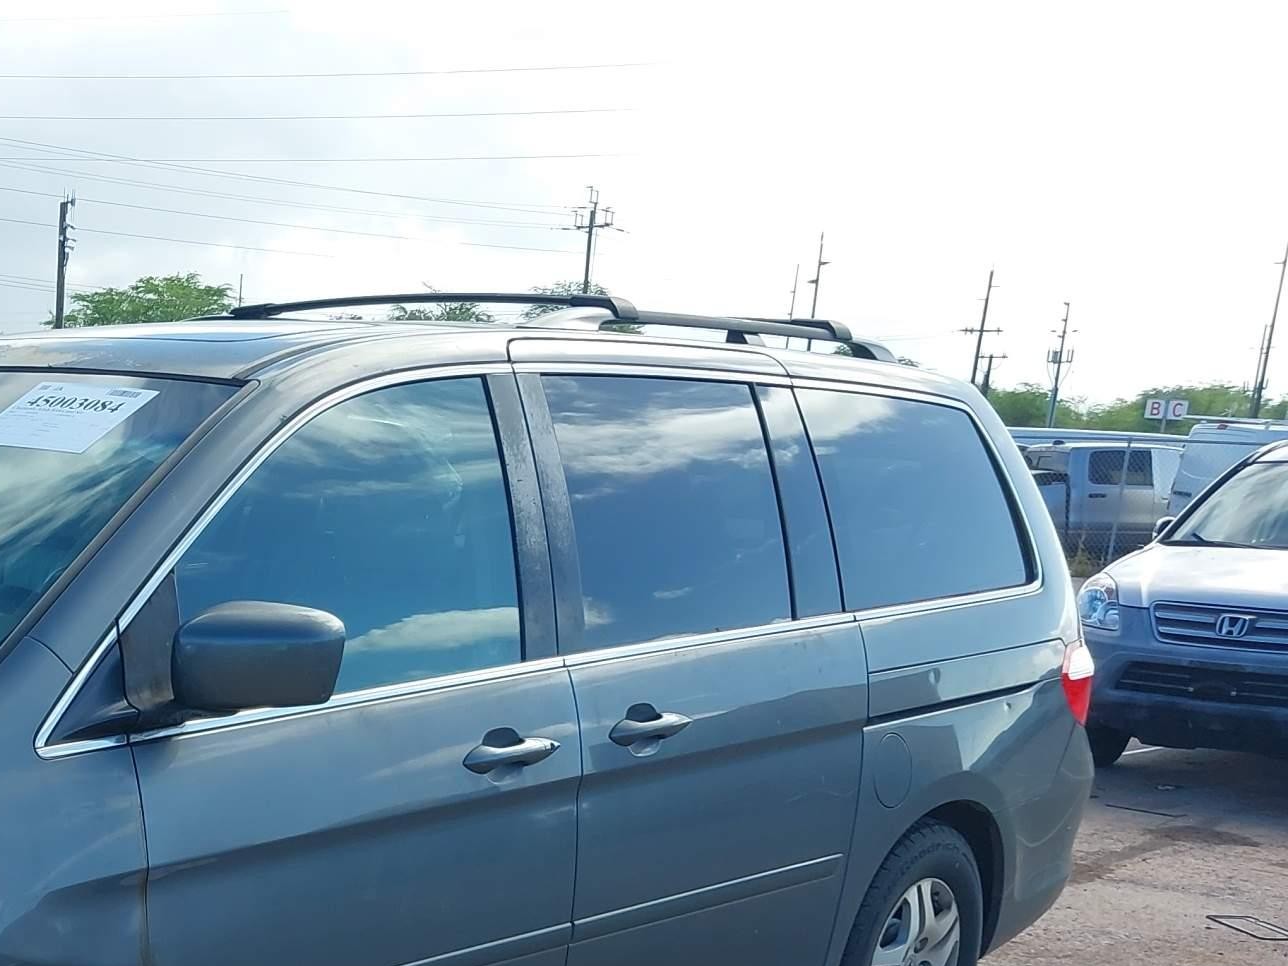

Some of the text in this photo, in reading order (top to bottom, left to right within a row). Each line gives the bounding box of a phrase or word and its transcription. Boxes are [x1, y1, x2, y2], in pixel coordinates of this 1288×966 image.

[27, 395, 126, 413] 45003084
[1150, 401, 1183, 417] B C
